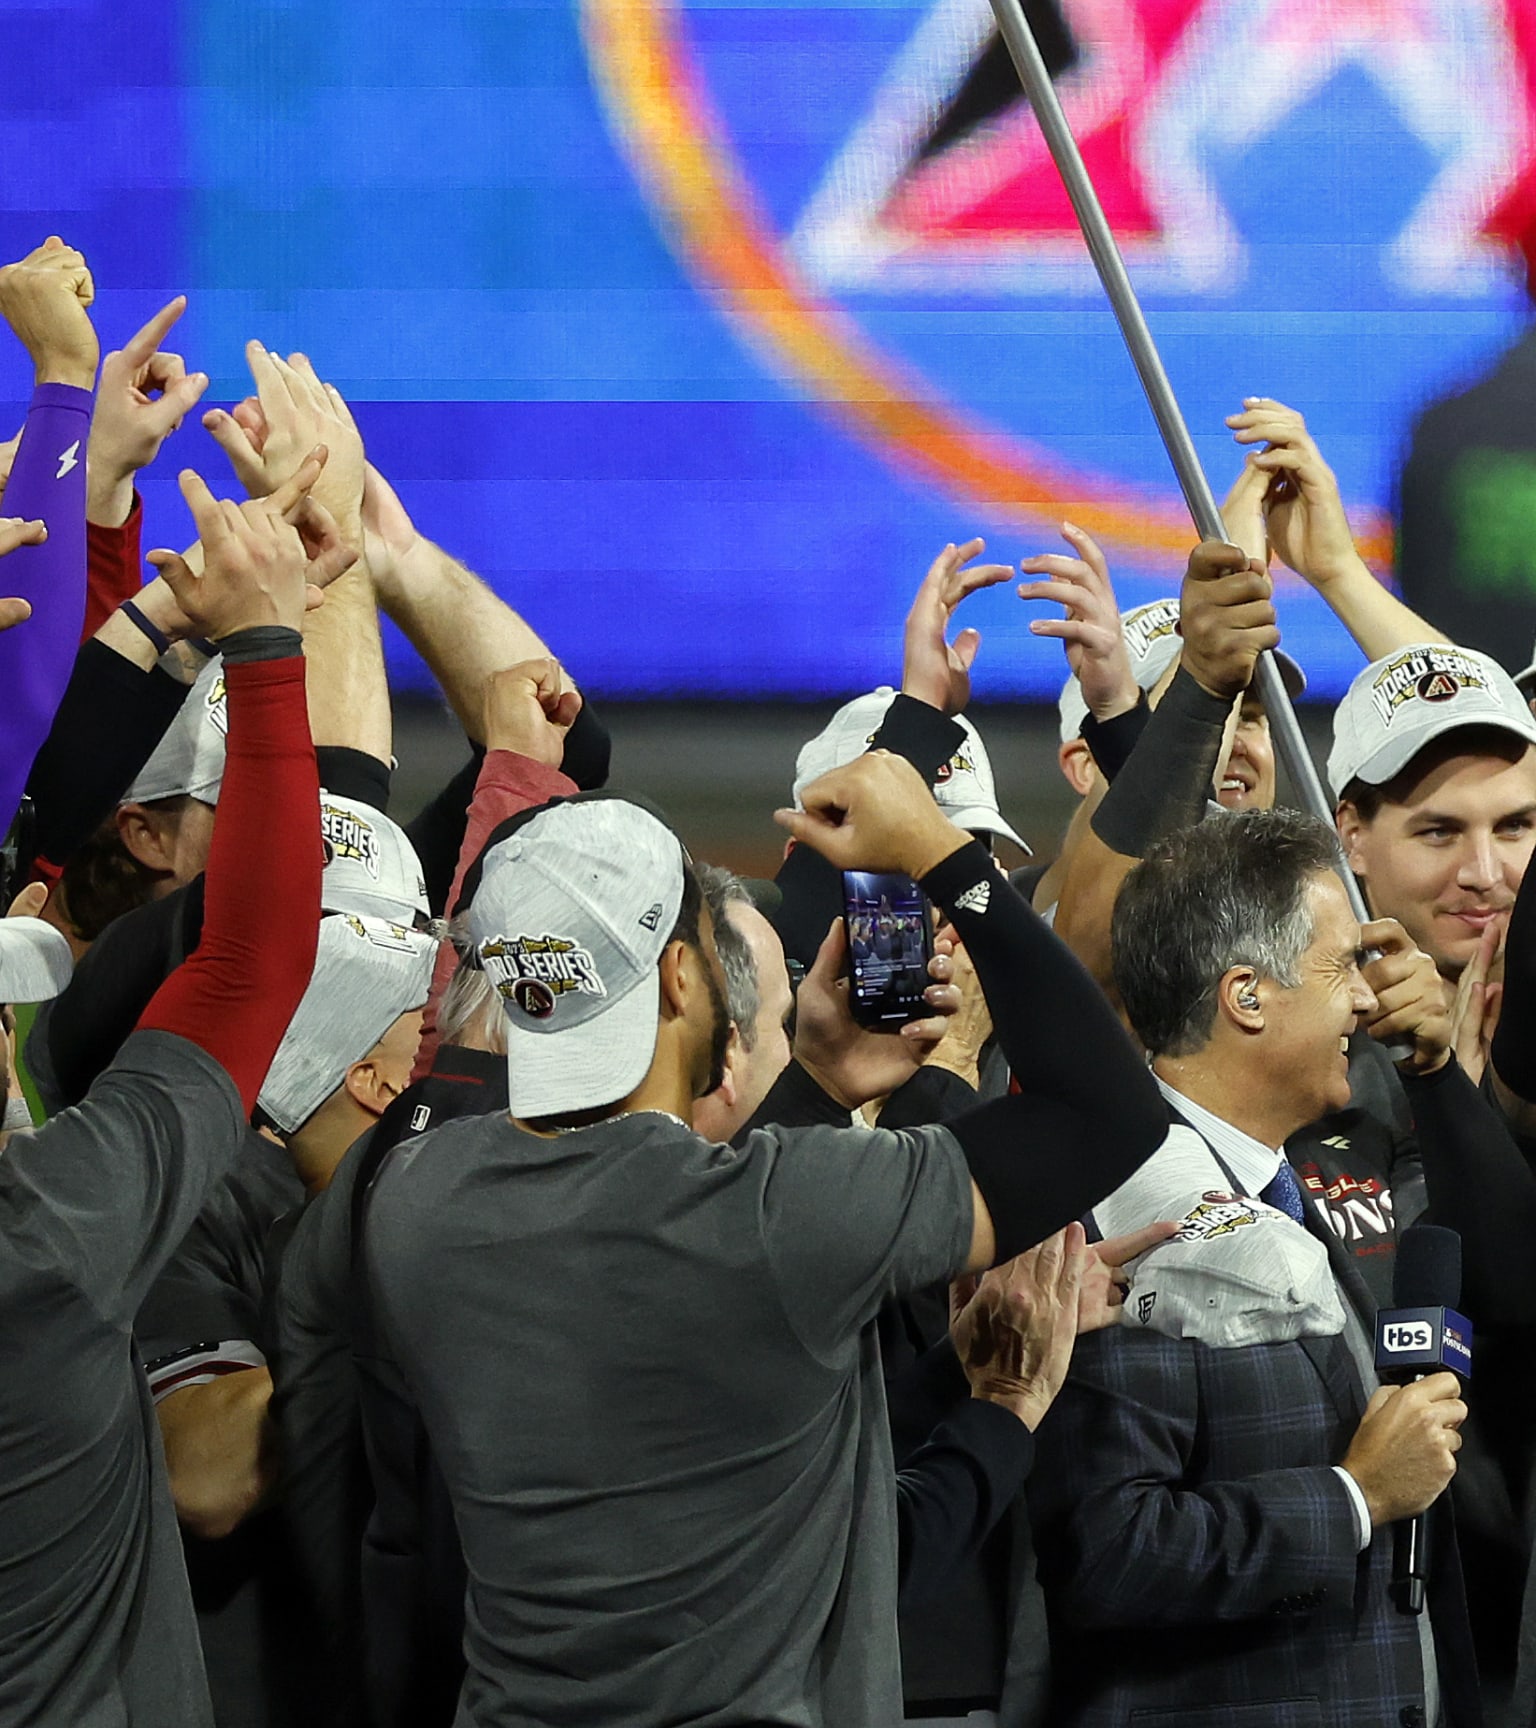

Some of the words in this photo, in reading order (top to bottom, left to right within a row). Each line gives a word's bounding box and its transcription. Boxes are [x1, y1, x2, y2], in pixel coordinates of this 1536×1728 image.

[1371, 656, 1429, 728] WORLD
[523, 950, 608, 997] SERIES
[1388, 1327, 1428, 1347] tbs
